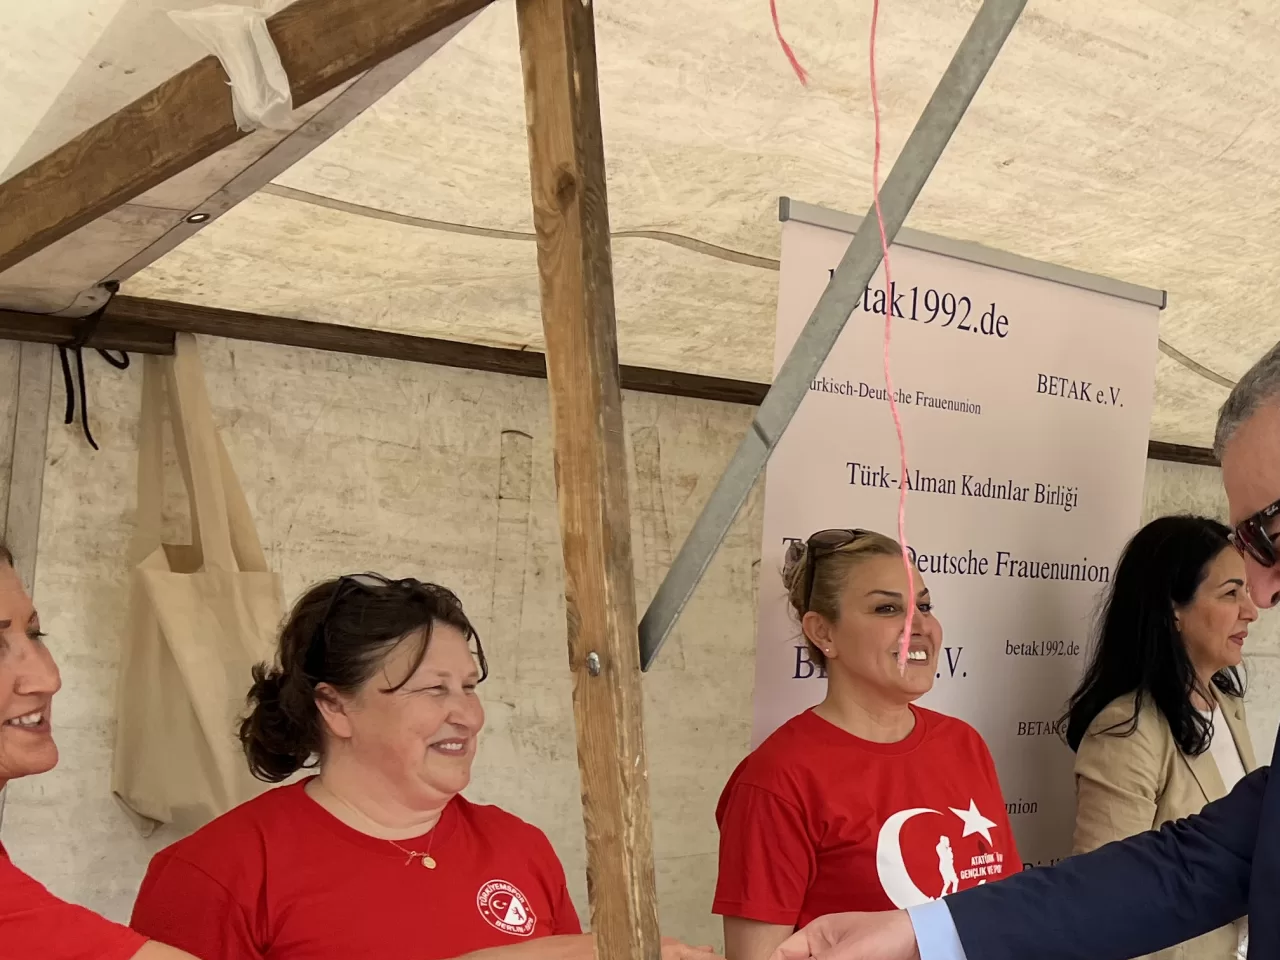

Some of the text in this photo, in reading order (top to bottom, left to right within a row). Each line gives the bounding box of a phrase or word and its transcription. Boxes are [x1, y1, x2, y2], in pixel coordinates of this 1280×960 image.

[828, 269, 1009, 338] tak1992.de
[809, 376, 982, 415] ürkisch-Deutche Frauenunion
[1037, 373, 1125, 408] BETAK e.V.
[846, 462, 1079, 511] Türk-Alman Kadınlar Birliği
[995, 550, 1110, 583] Frauenunion
[1005, 639, 1080, 657] betak1992.de
